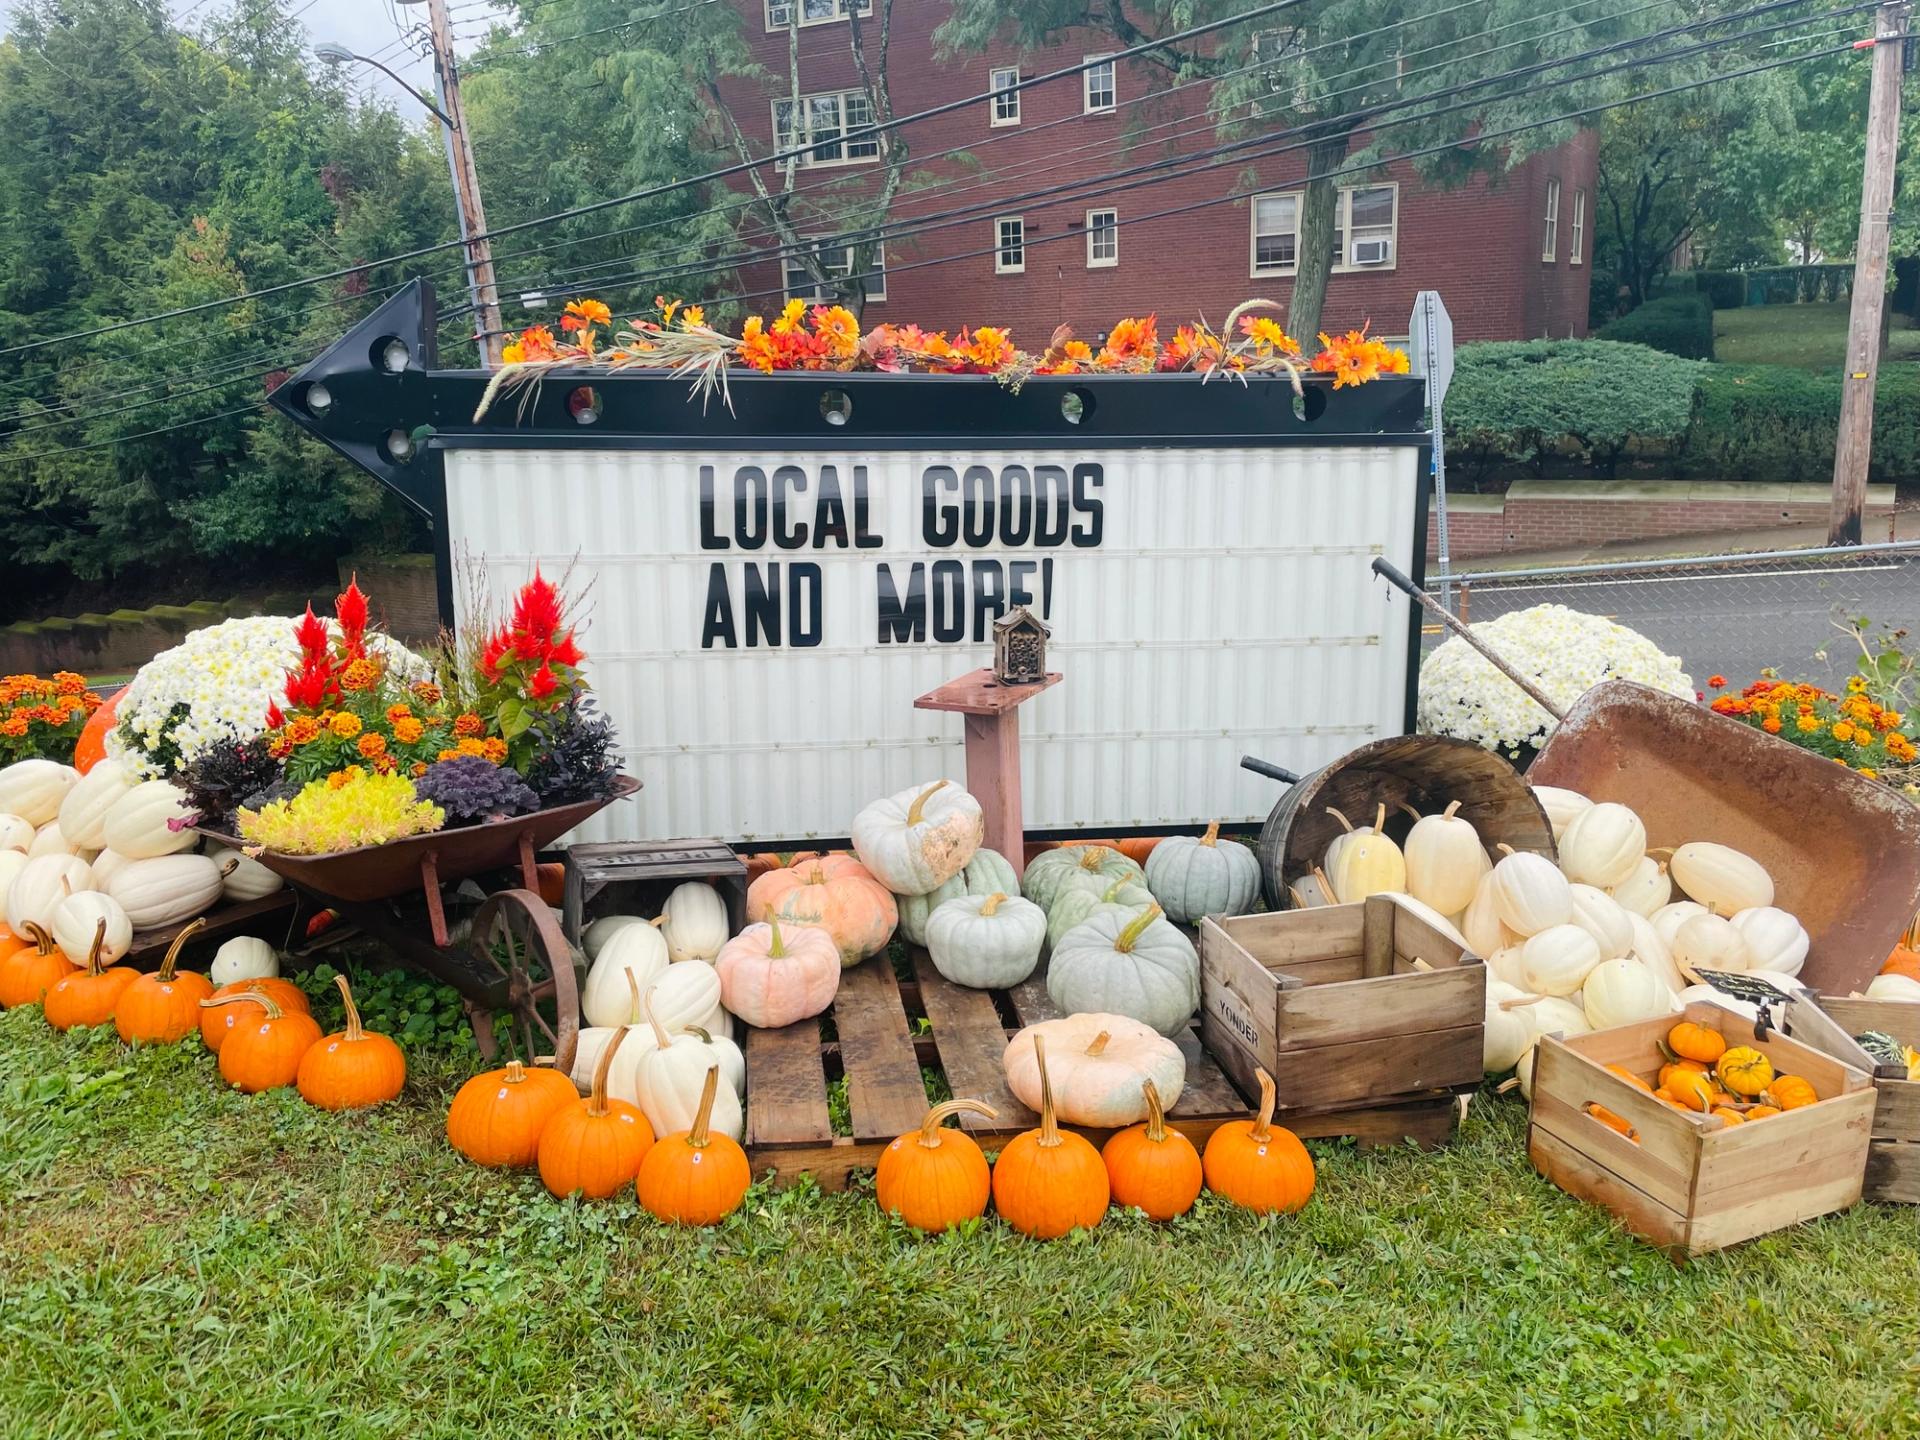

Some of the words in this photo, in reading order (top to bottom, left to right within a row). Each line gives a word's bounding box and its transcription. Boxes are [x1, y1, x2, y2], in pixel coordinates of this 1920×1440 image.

[699, 465, 884, 550] LOCAL
[922, 462, 1104, 548] GOODS
[701, 561, 823, 648] AND
[598, 851, 711, 864] PETERS
[1220, 1000, 1258, 1048] YONDER
